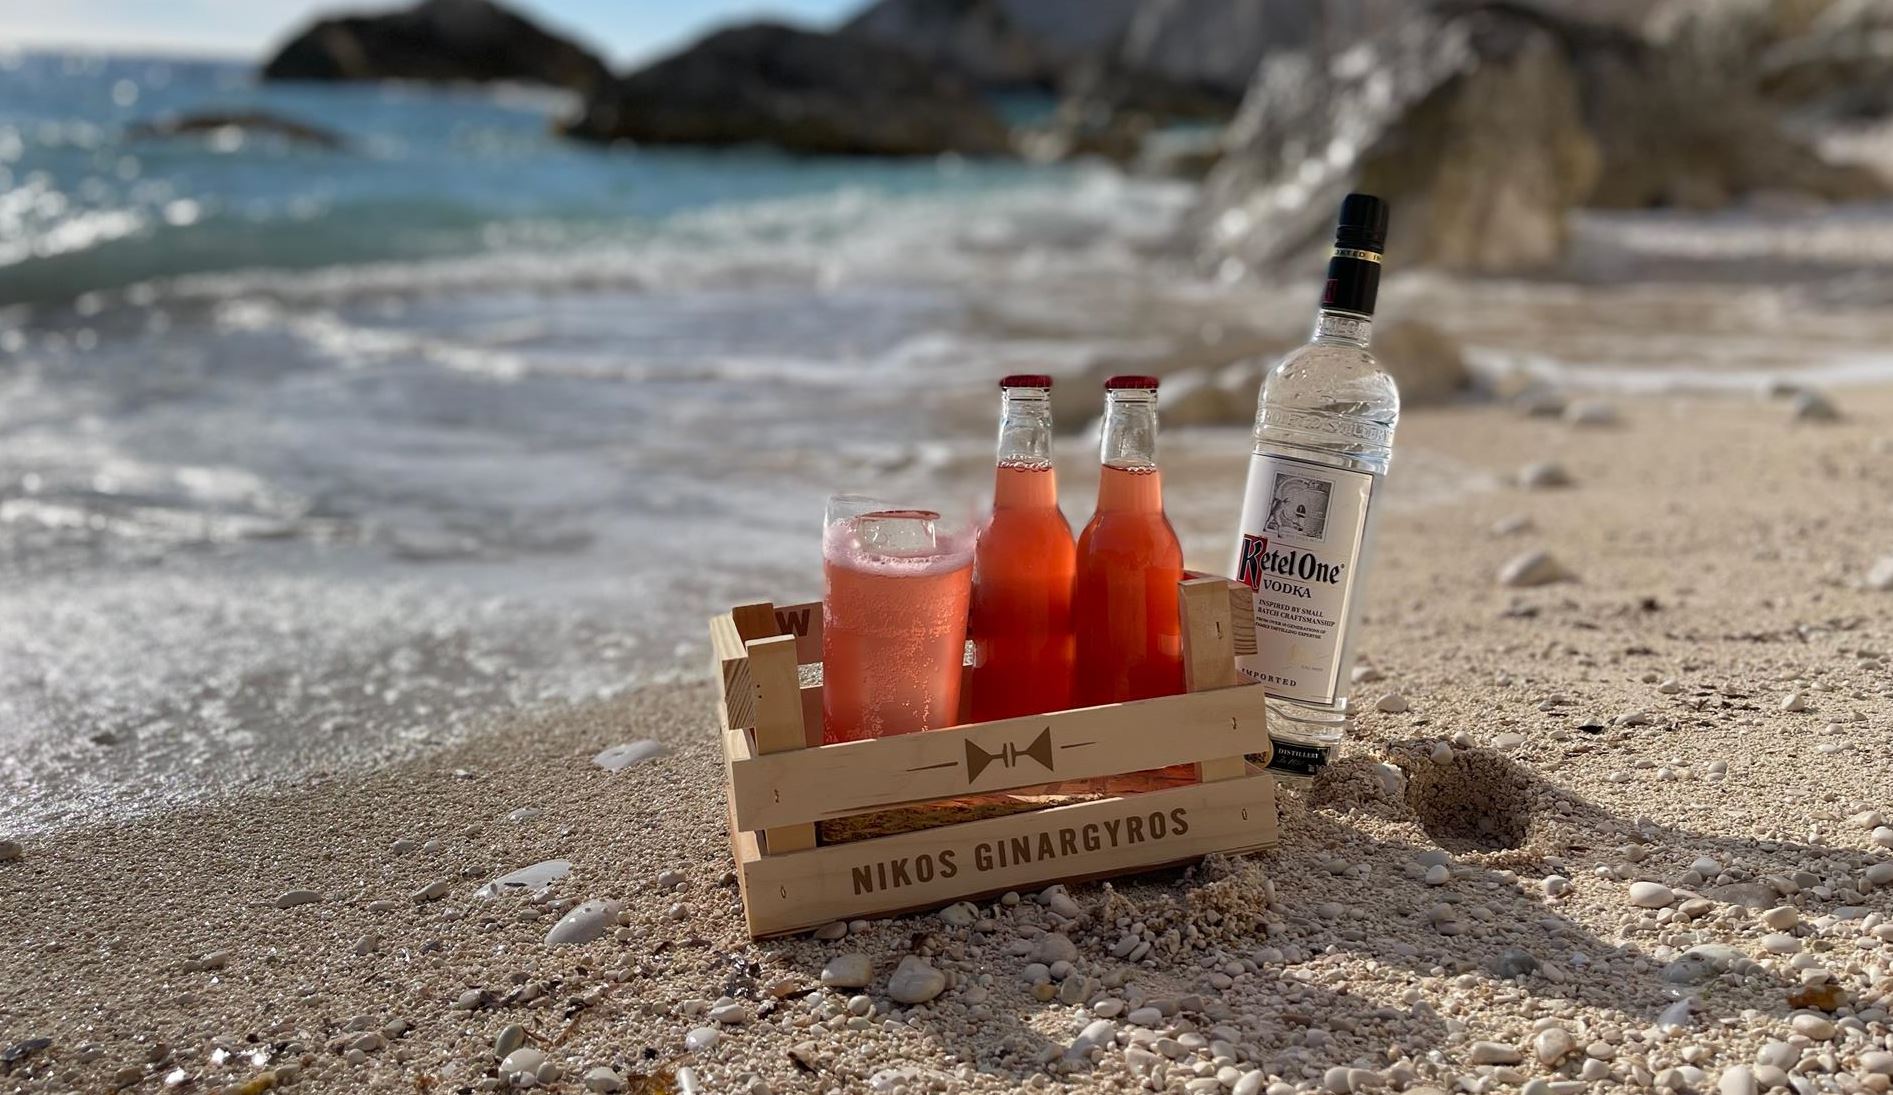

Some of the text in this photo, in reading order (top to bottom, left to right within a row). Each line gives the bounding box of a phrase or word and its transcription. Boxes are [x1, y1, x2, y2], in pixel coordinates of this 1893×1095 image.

[1238, 536, 1297, 591] Ketel
[1263, 579, 1312, 598] VODKA
[1257, 606, 1336, 627] BATCH CRAFTSMANSHIP
[1259, 599, 1290, 611] INSPIRED
[1301, 608, 1324, 617] SMALL
[852, 807, 1189, 895] NIKOS GINARGYROS
